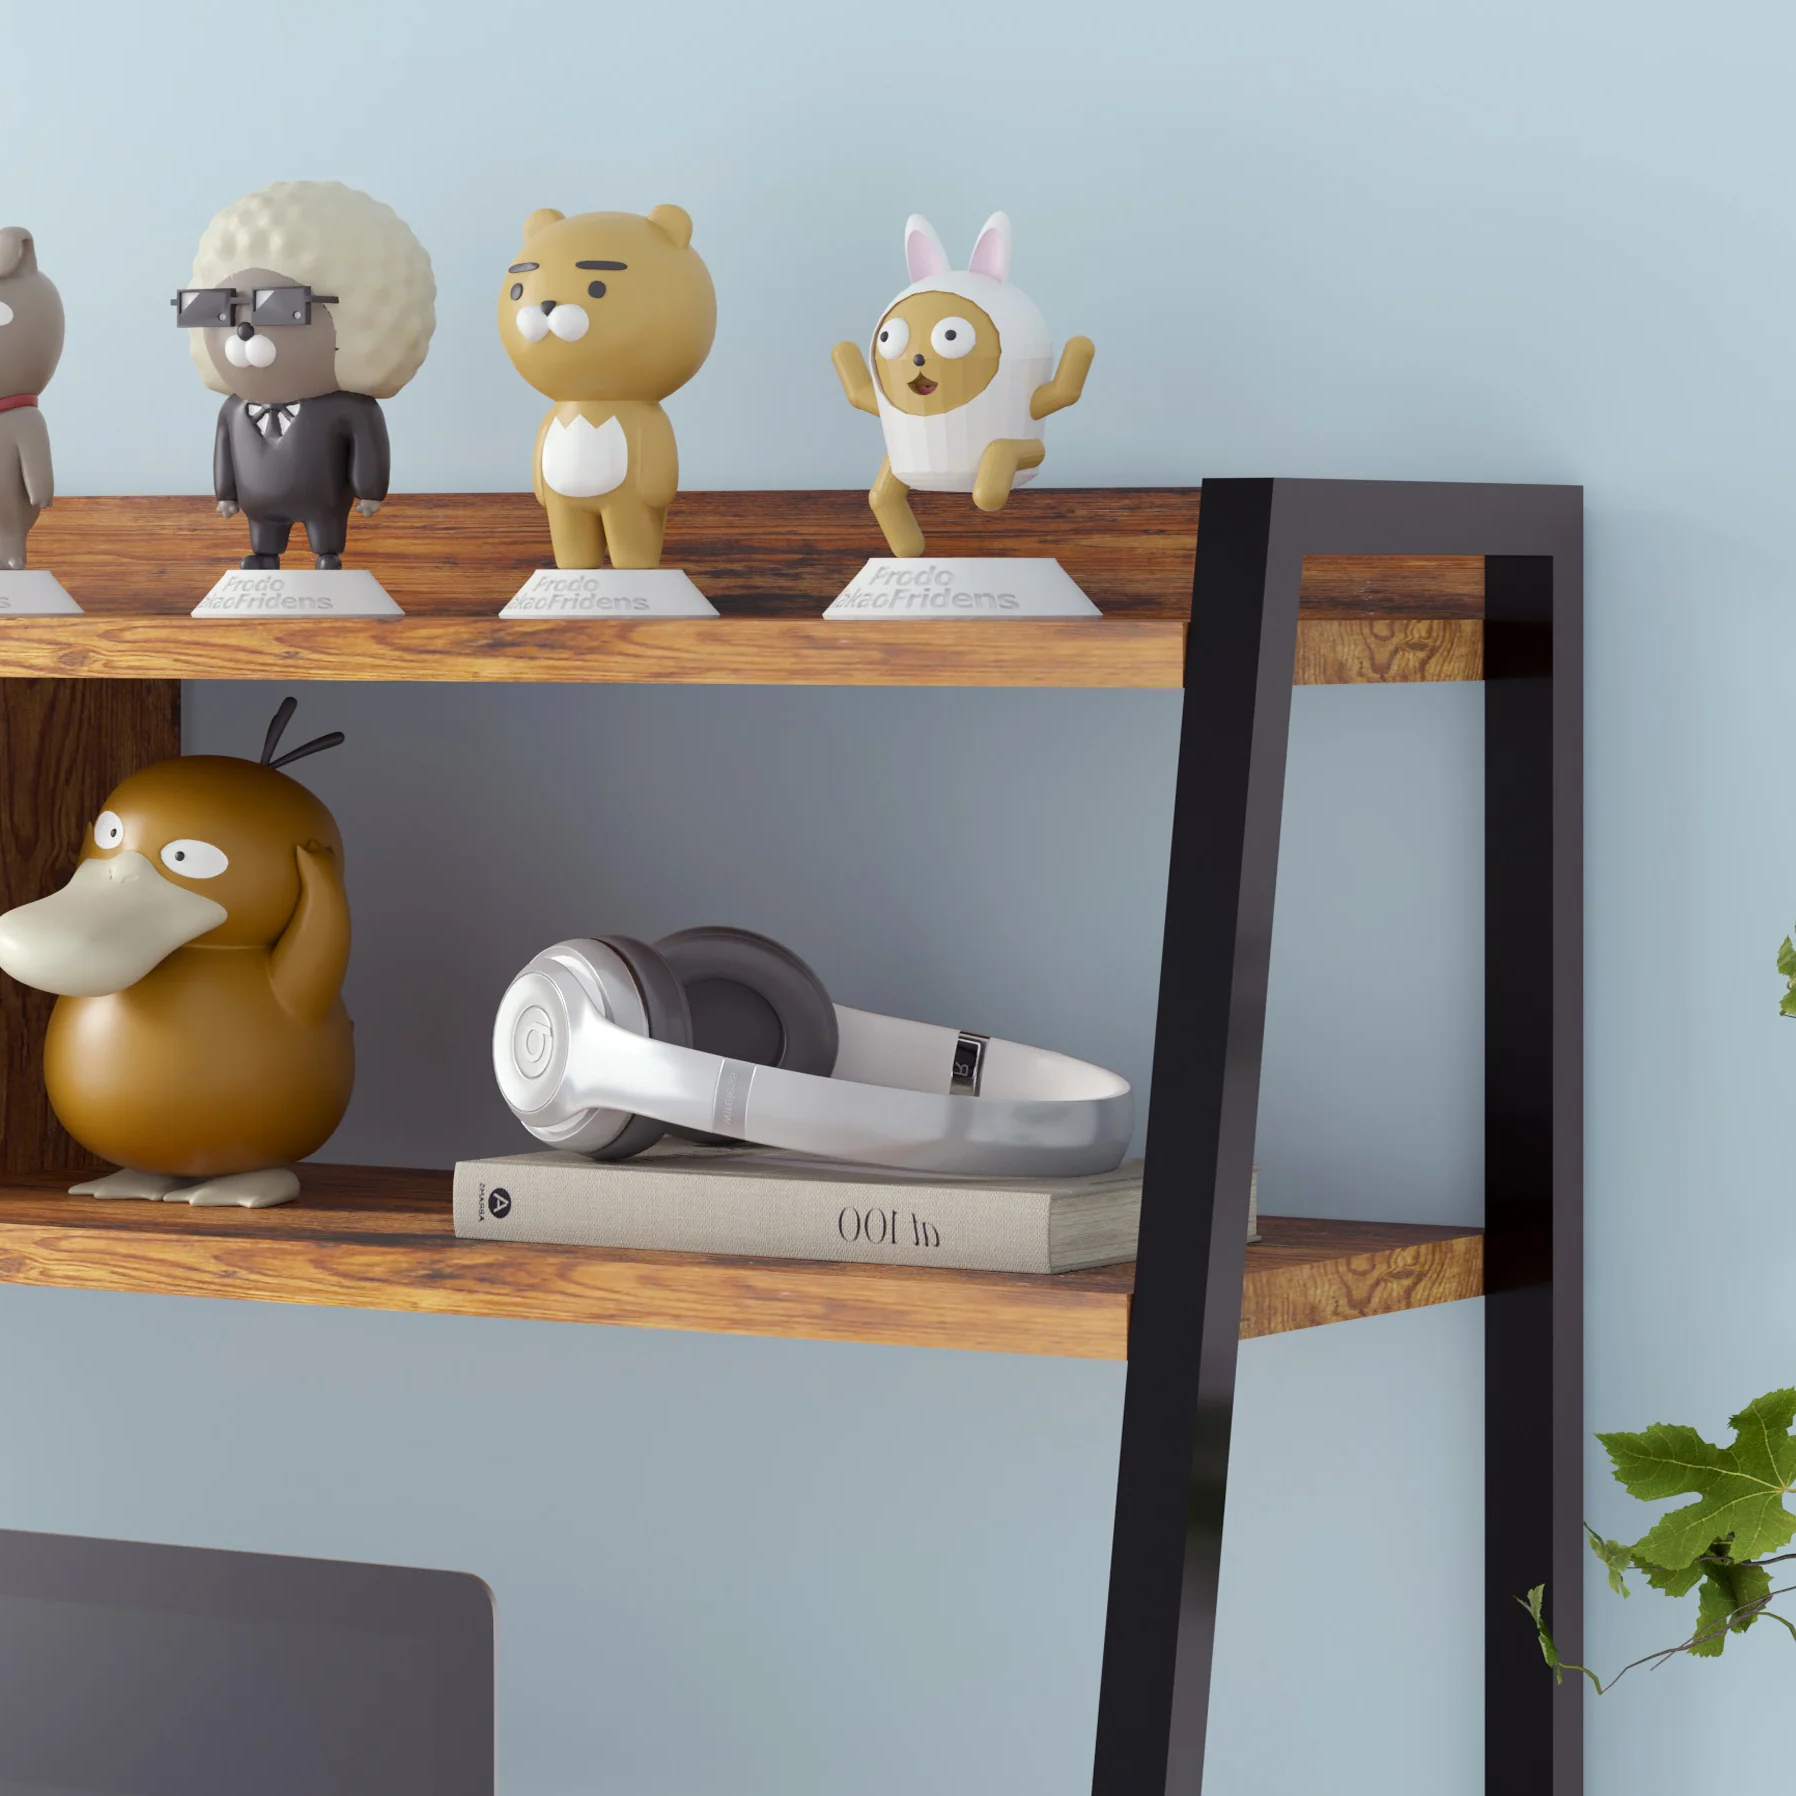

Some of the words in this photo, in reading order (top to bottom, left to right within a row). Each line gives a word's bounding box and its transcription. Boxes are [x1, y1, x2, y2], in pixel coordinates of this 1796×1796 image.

[222, 576, 286, 592] Frodo
[532, 575, 599, 592] Frodo
[868, 565, 955, 587] Frodo
